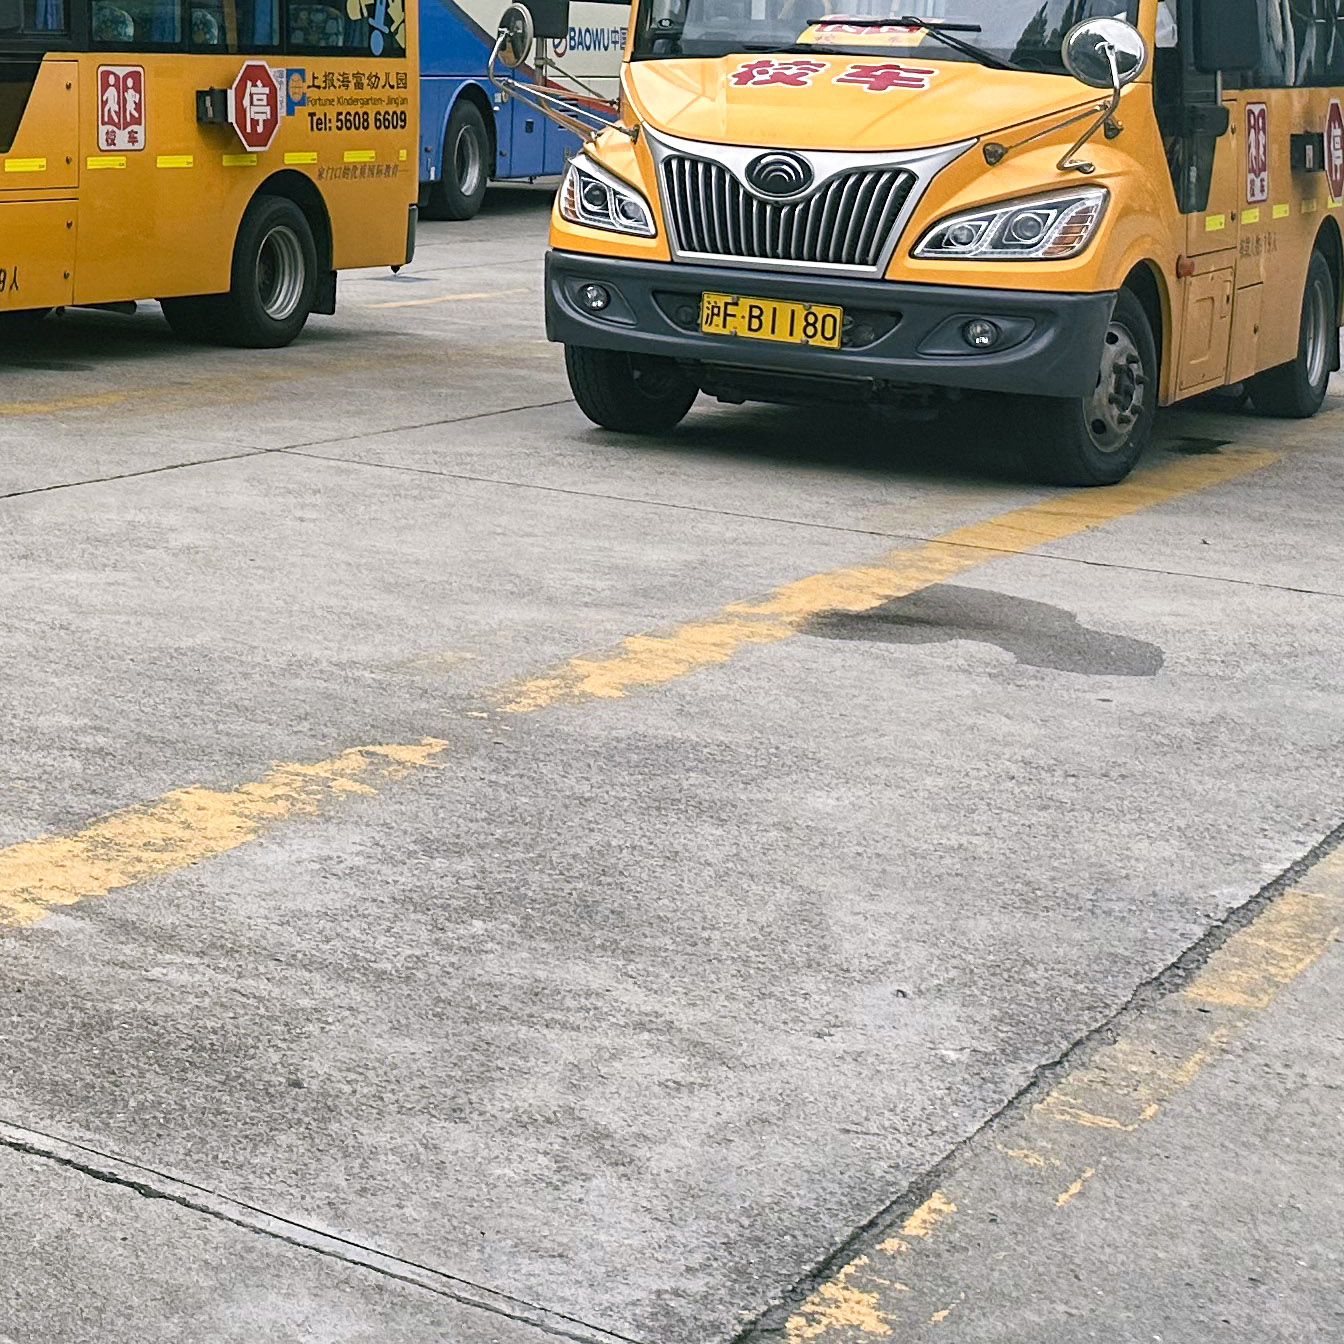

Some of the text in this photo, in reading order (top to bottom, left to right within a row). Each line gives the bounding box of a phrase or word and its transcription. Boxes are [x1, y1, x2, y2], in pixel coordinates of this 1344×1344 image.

[306, 70, 408, 90] 上报海富幼儿园
[731, 60, 935, 91] 校车
[242, 79, 272, 134] 停
[308, 110, 407, 131] Tel: 5608 6609
[105, 129, 139, 146] 校车
